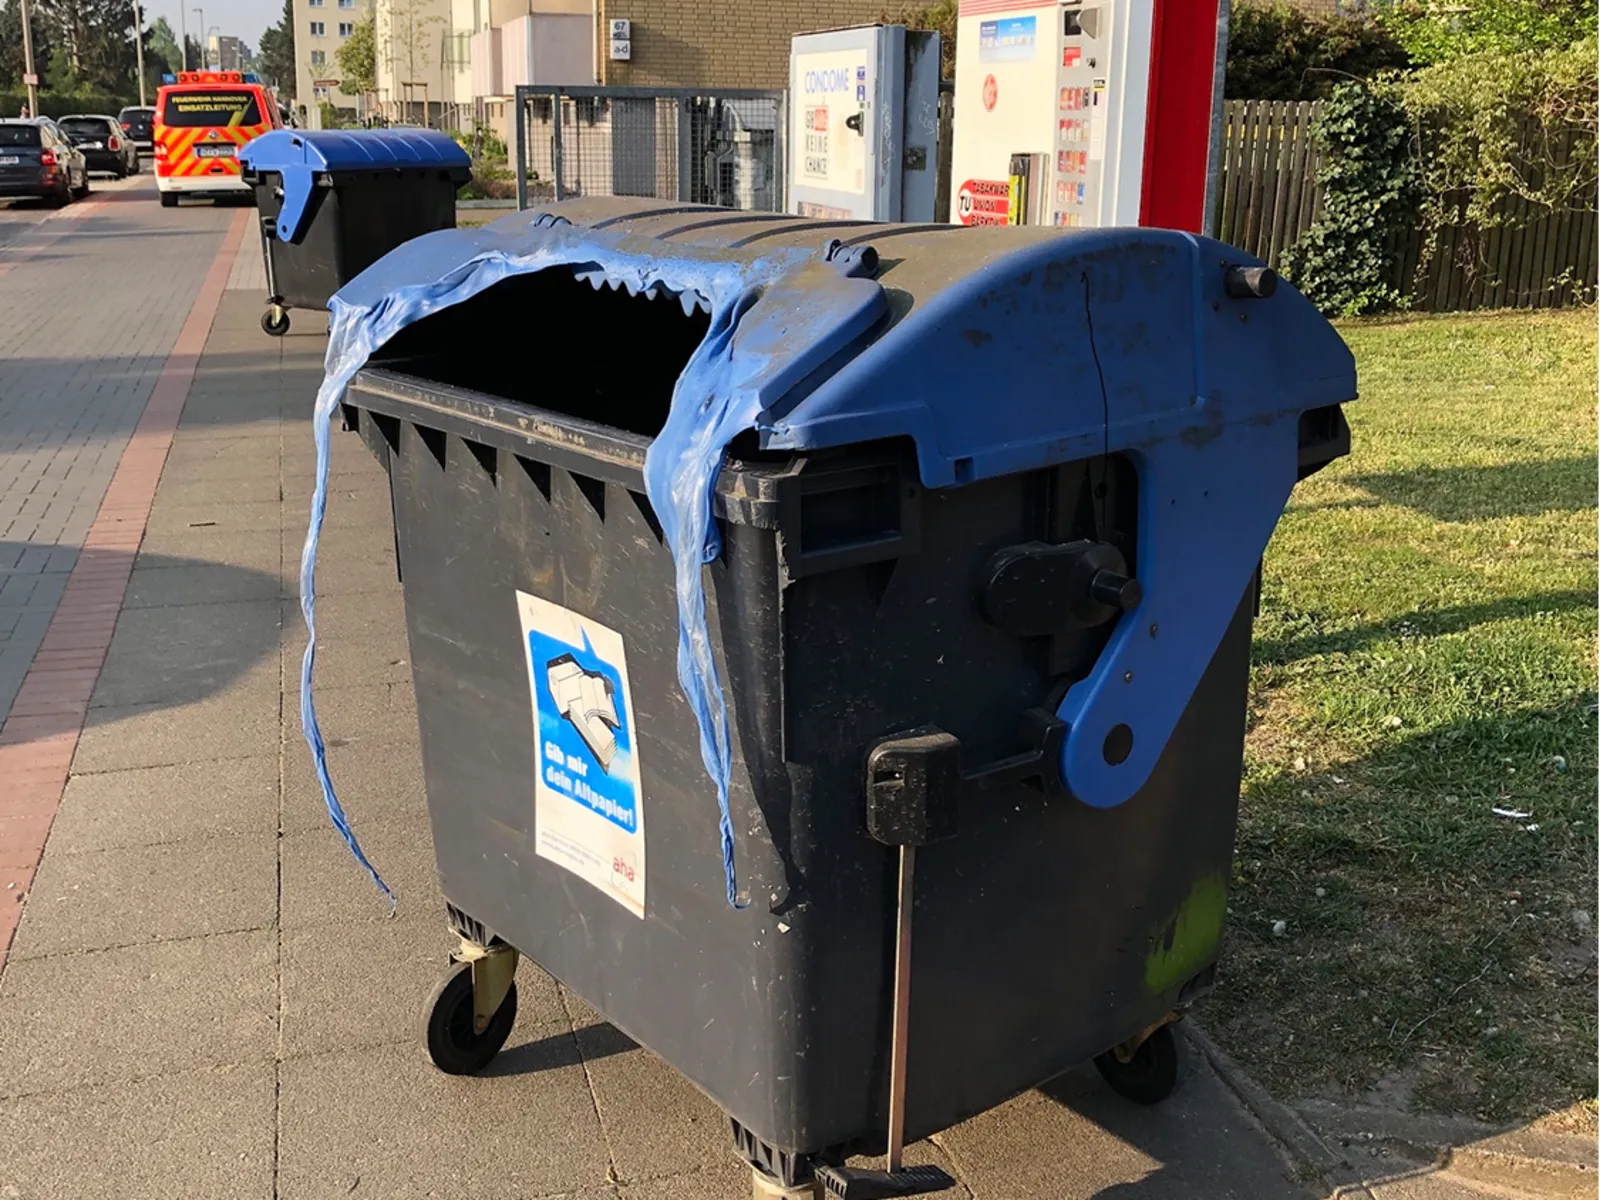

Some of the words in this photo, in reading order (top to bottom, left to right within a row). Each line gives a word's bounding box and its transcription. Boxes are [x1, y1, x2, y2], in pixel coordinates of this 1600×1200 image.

[614, 21, 626, 30] 67
[614, 44, 628, 53] a-d
[805, 68, 849, 94] CONDOME
[178, 103, 242, 112] EINSATZLEITUNG
[805, 156, 828, 176] CHANCE
[960, 196, 971, 212] TU
[973, 199, 996, 211] UNION
[545, 740, 565, 765] Gib
[567, 756, 588, 777] mir
[546, 765, 572, 792] dein
[574, 778, 634, 828] Altpapier!
[612, 856, 635, 882] aha
